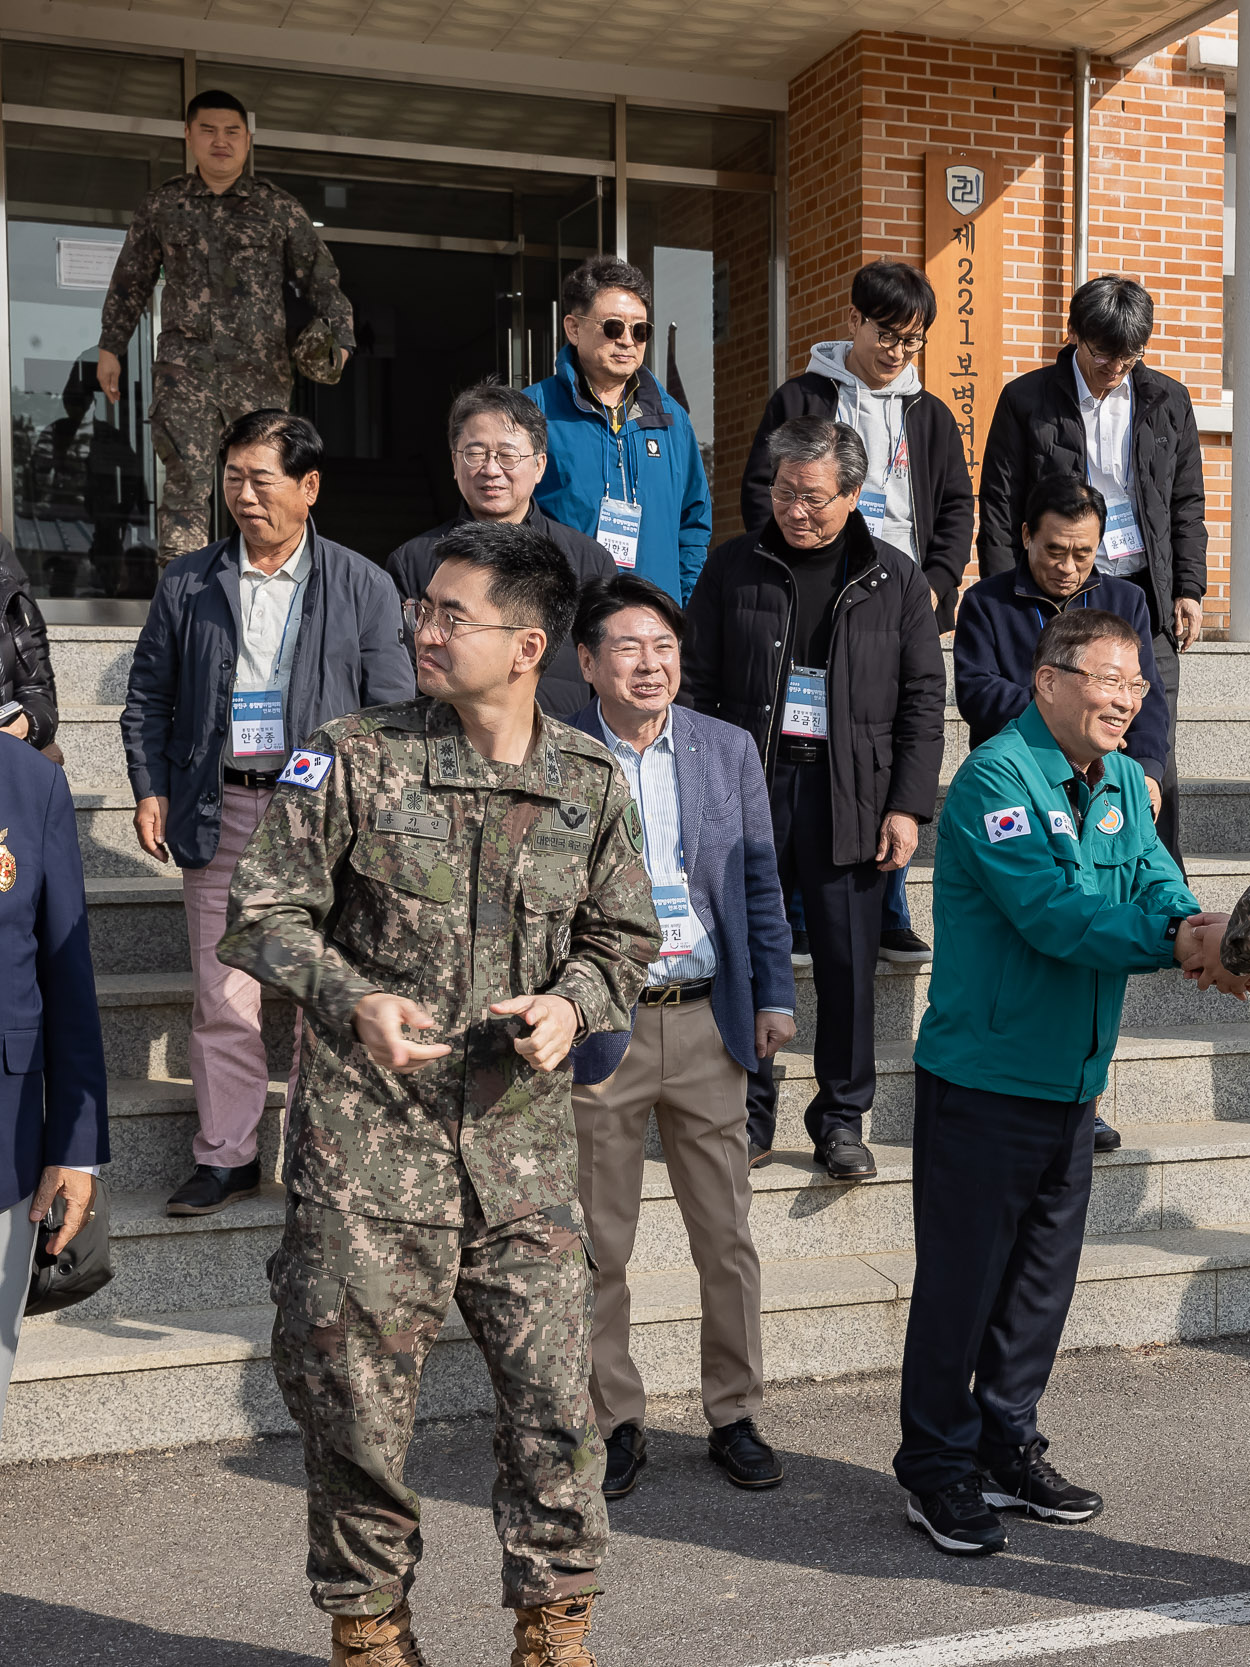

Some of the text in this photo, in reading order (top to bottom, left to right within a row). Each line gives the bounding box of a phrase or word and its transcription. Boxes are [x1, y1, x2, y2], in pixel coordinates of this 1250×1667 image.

[790, 714, 821, 728] 오금진
[241, 732, 275, 744] 안승종
[536, 835, 592, 853] 대한민국 육군 RO
[661, 928, 682, 942] 영진
